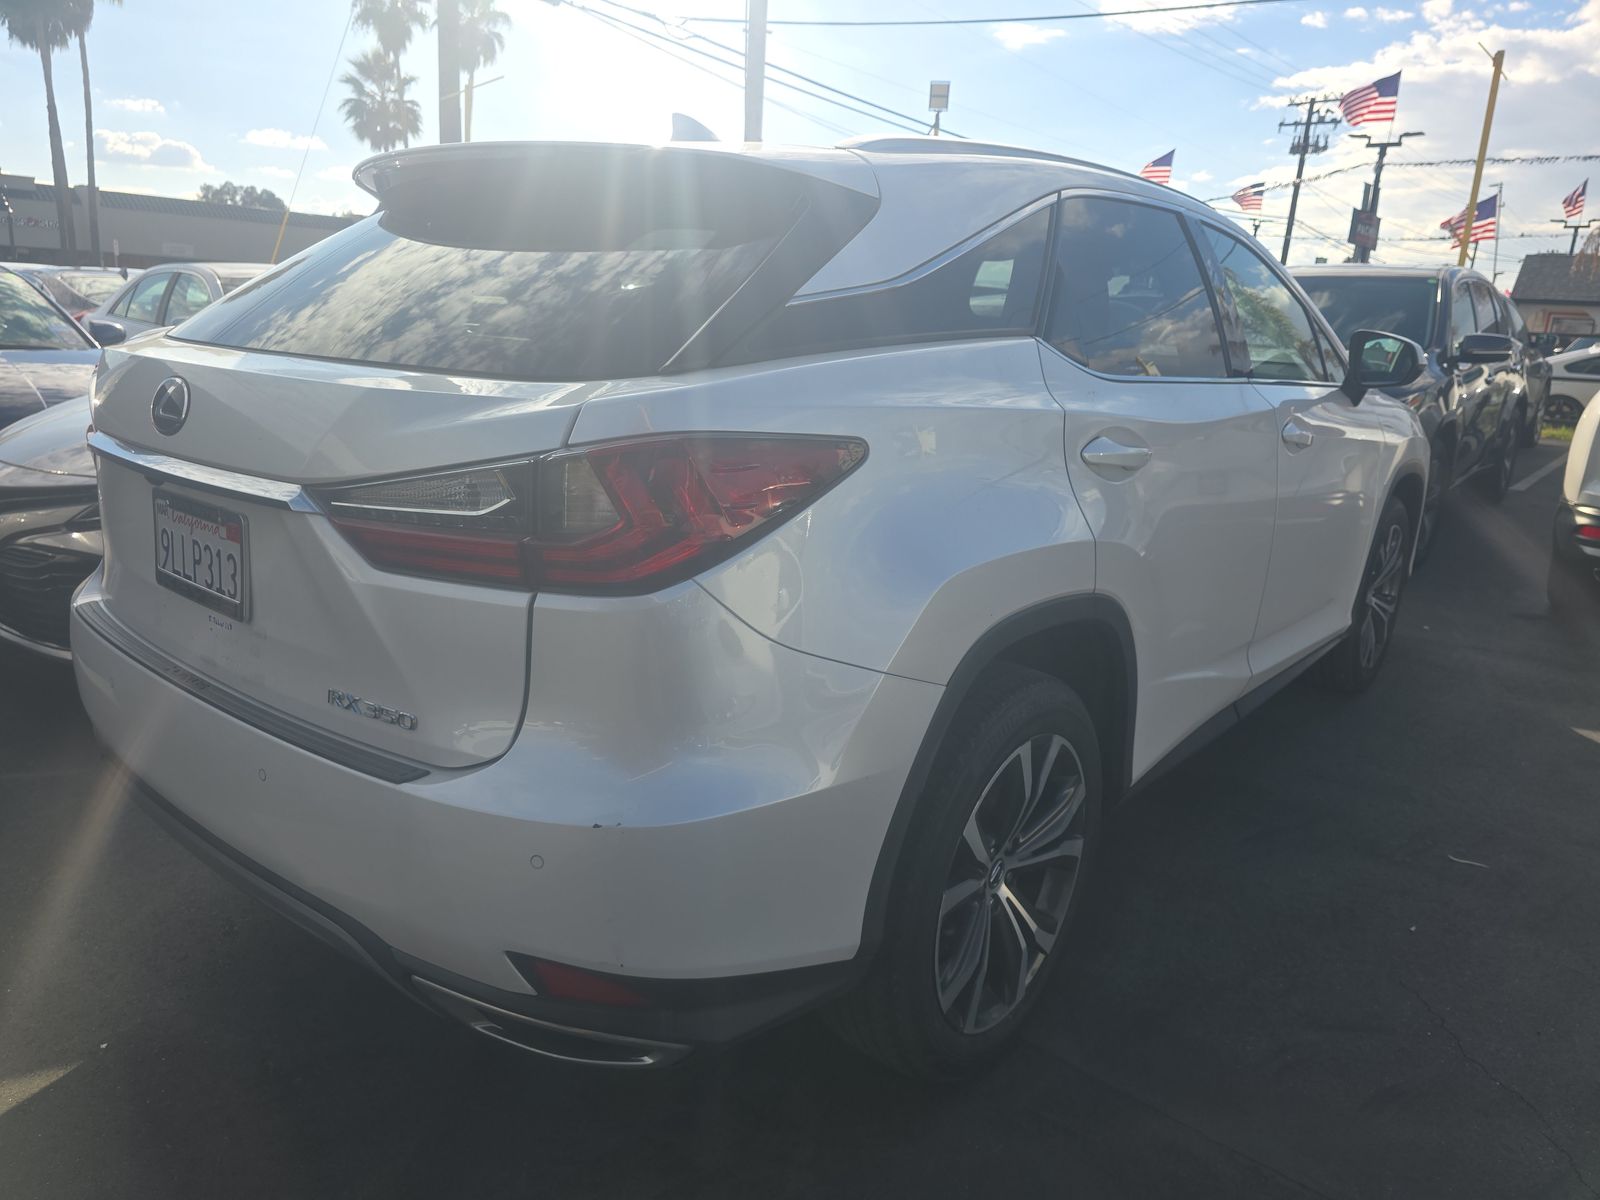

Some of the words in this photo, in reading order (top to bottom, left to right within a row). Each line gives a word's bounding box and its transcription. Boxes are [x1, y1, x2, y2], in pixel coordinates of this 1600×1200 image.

[172, 510, 224, 537] California
[161, 527, 238, 598] 9LLP313
[328, 688, 361, 715] RX
[364, 700, 418, 731] 350
